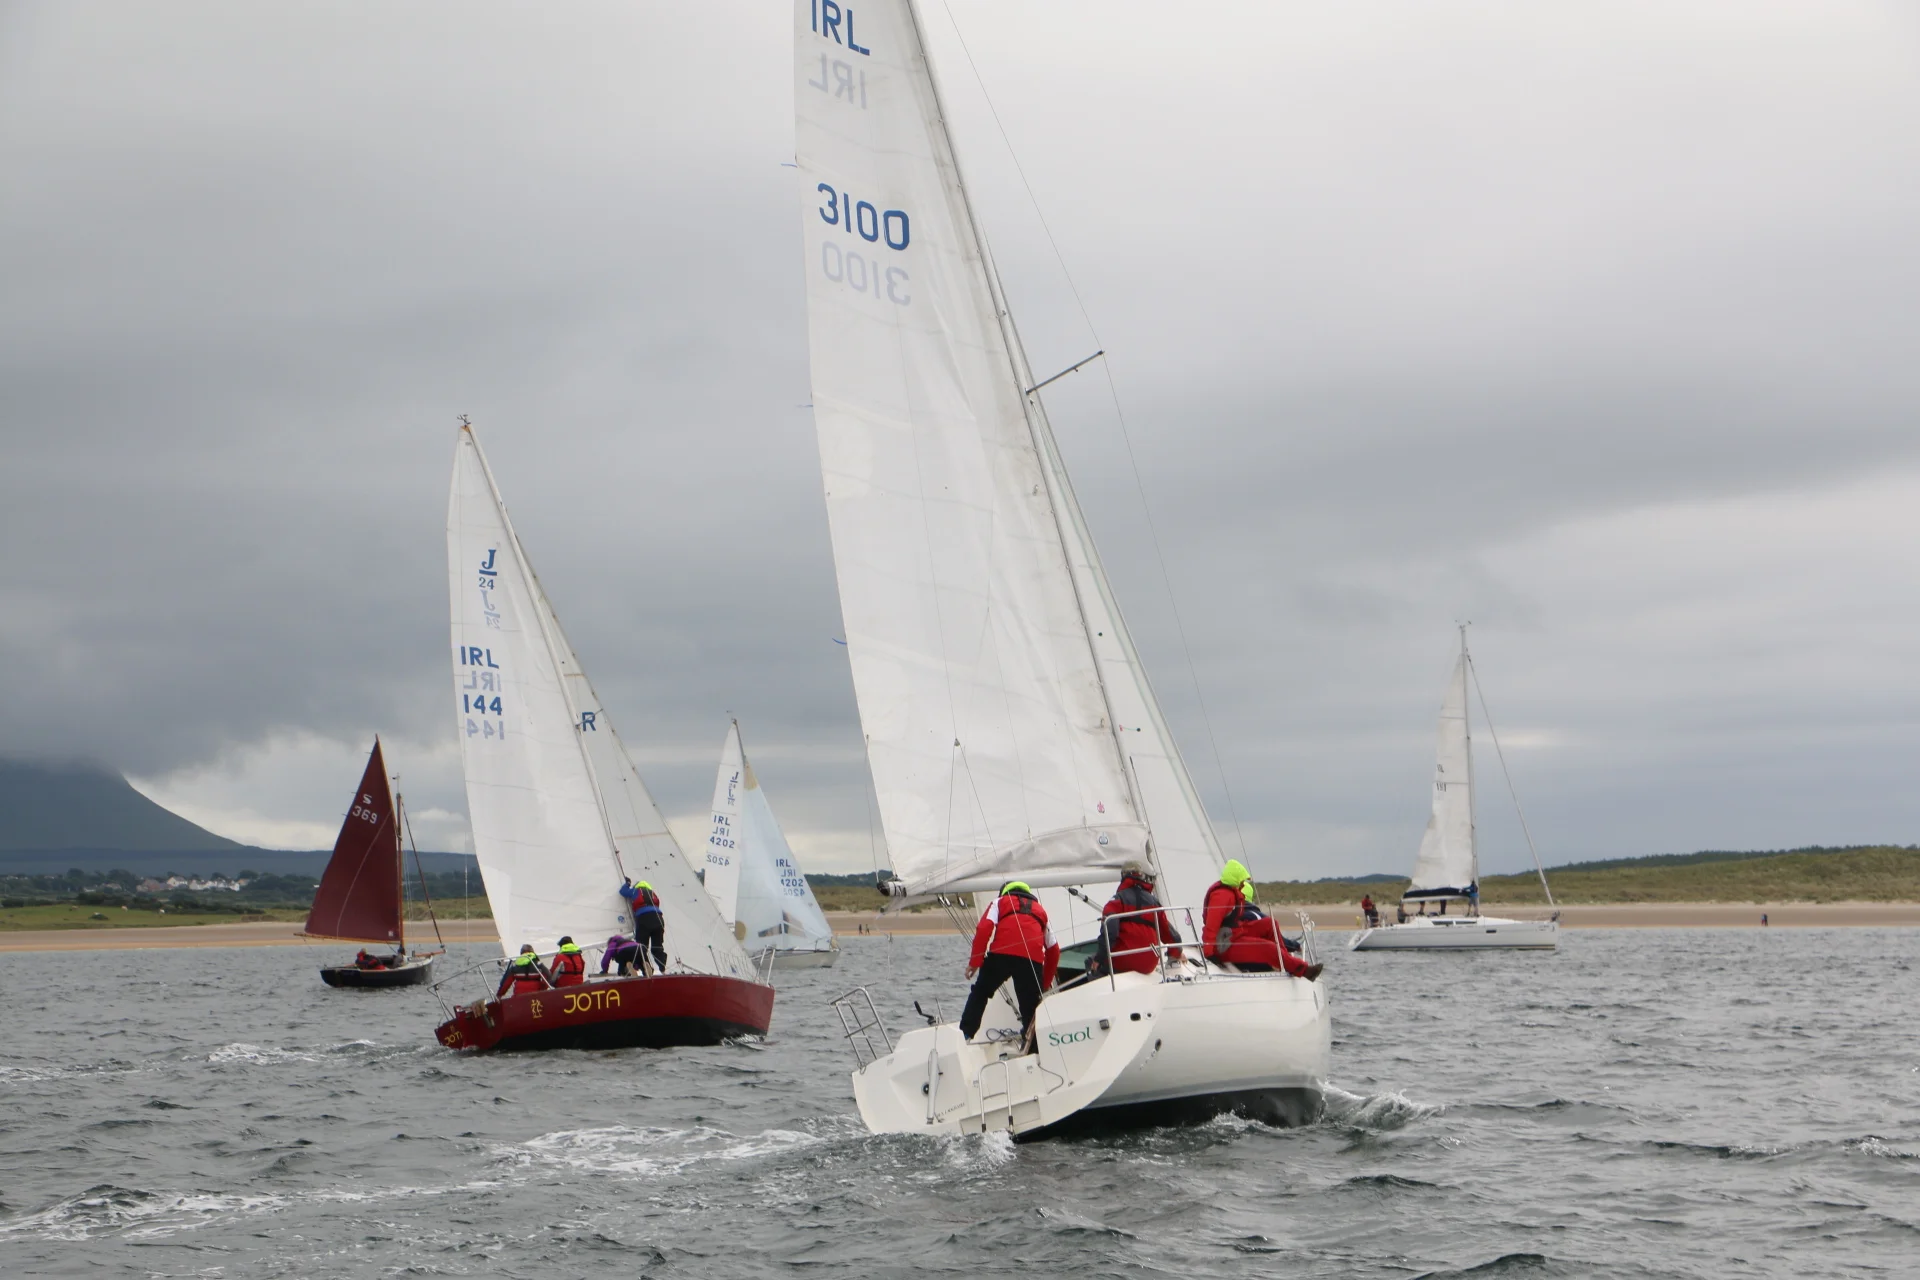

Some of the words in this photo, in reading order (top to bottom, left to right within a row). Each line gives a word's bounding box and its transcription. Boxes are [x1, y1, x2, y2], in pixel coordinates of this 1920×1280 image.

[811, 0, 870, 56] IRL
[817, 182, 910, 251] 3100
[481, 549, 496, 569] J
[478, 576, 495, 590] 24
[460, 646, 500, 669] IRL
[463, 694, 503, 716] 144
[582, 711, 597, 732] R
[362, 793, 372, 804] S
[352, 805, 378, 824] 369
[713, 815, 730, 826] IRL
[710, 836, 735, 848] 4202
[776, 859, 791, 867] IRL
[563, 989, 621, 1014] JOTA
[1048, 1026, 1094, 1047] Saol
